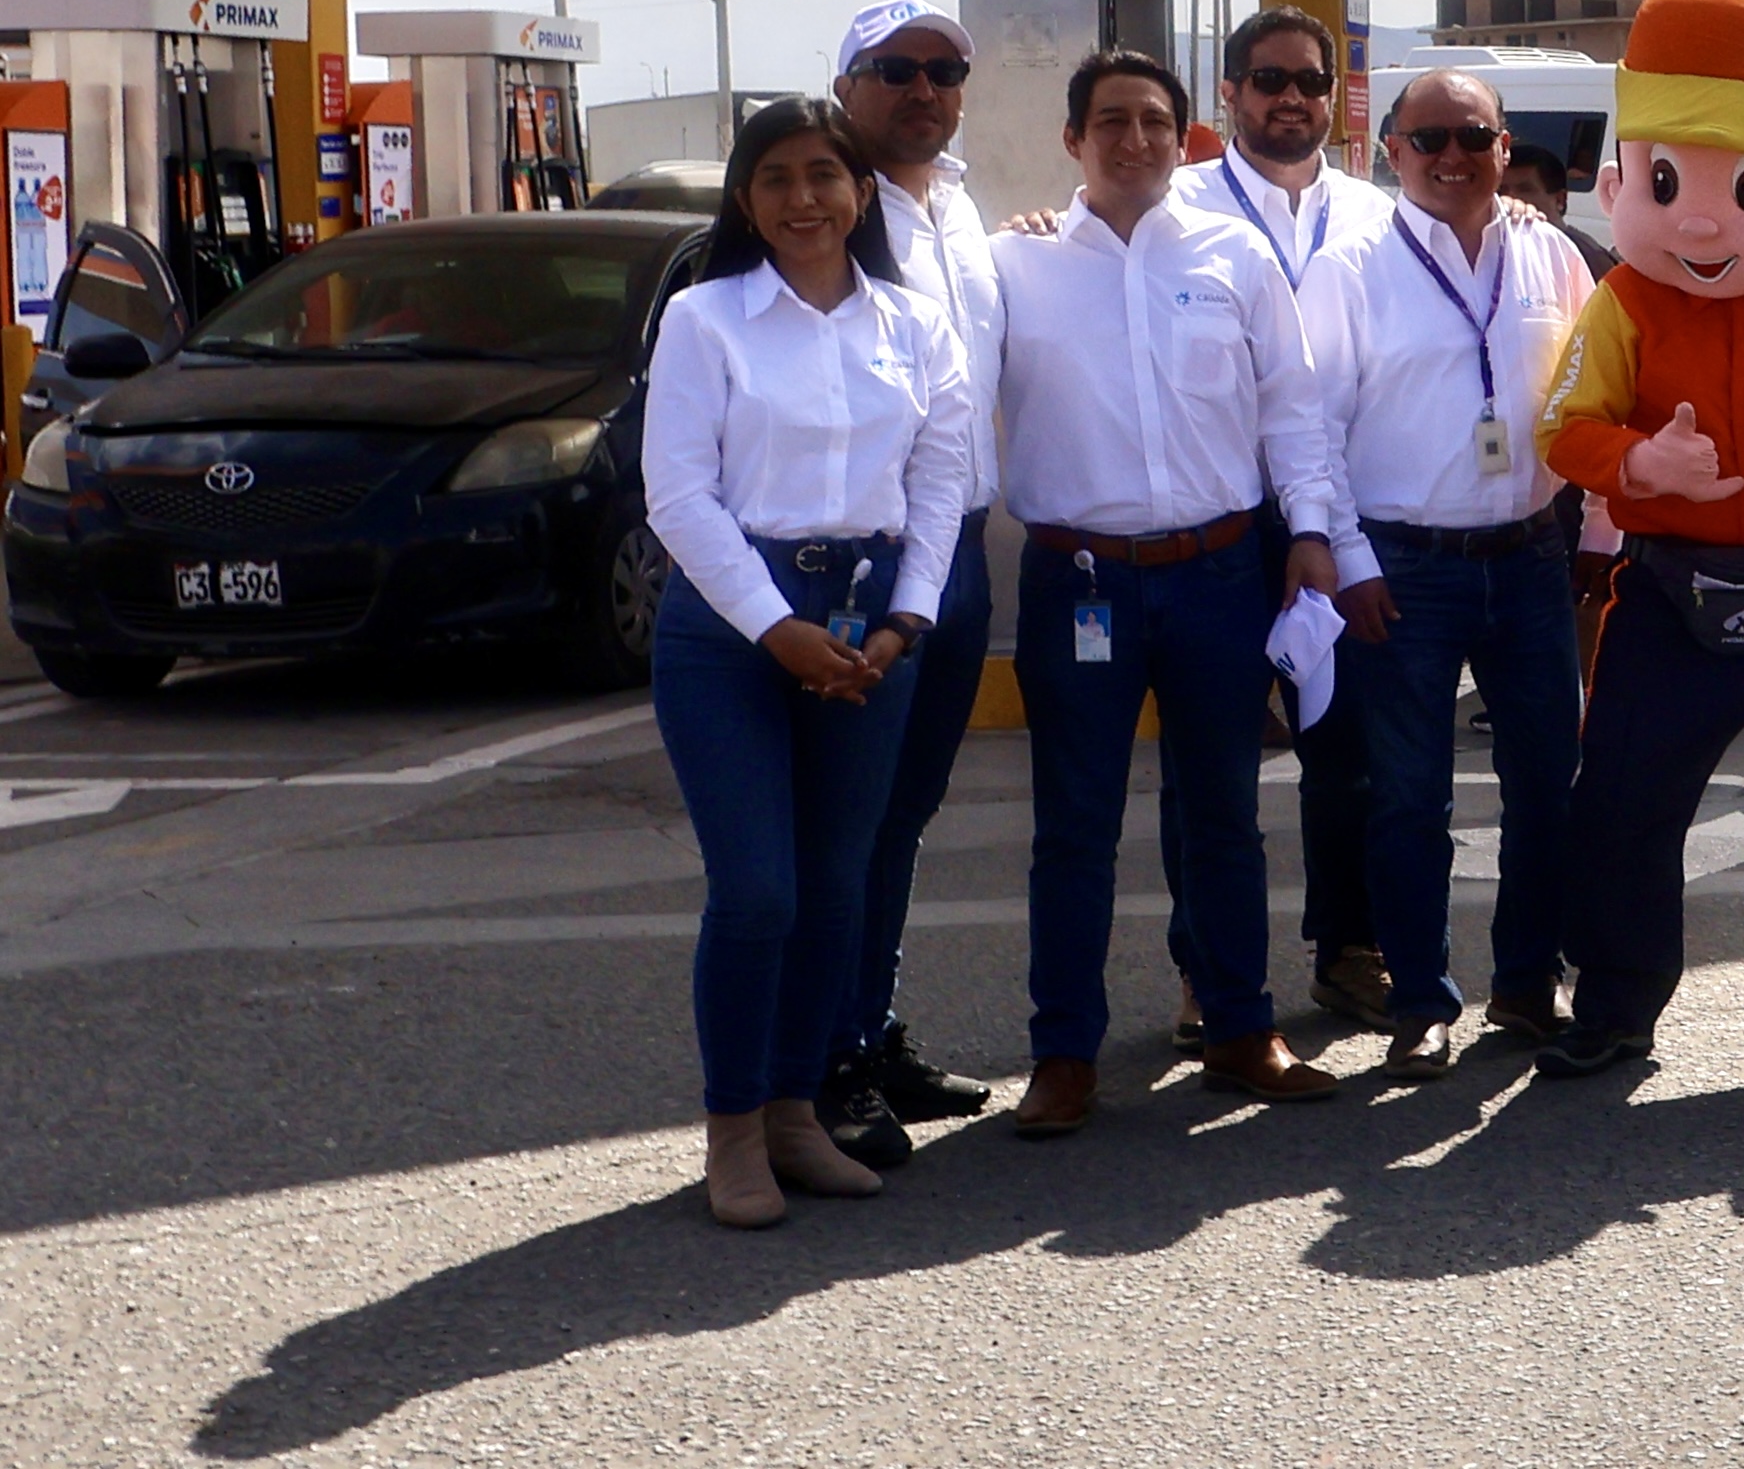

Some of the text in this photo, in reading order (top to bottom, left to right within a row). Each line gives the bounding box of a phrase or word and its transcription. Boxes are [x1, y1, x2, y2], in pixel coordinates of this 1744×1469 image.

[216, 3, 279, 29] PRIMAX
[538, 31, 584, 52] PRIMAX
[1543, 334, 1585, 421] PRIMAX
[178, 569, 279, 603] C3-596
